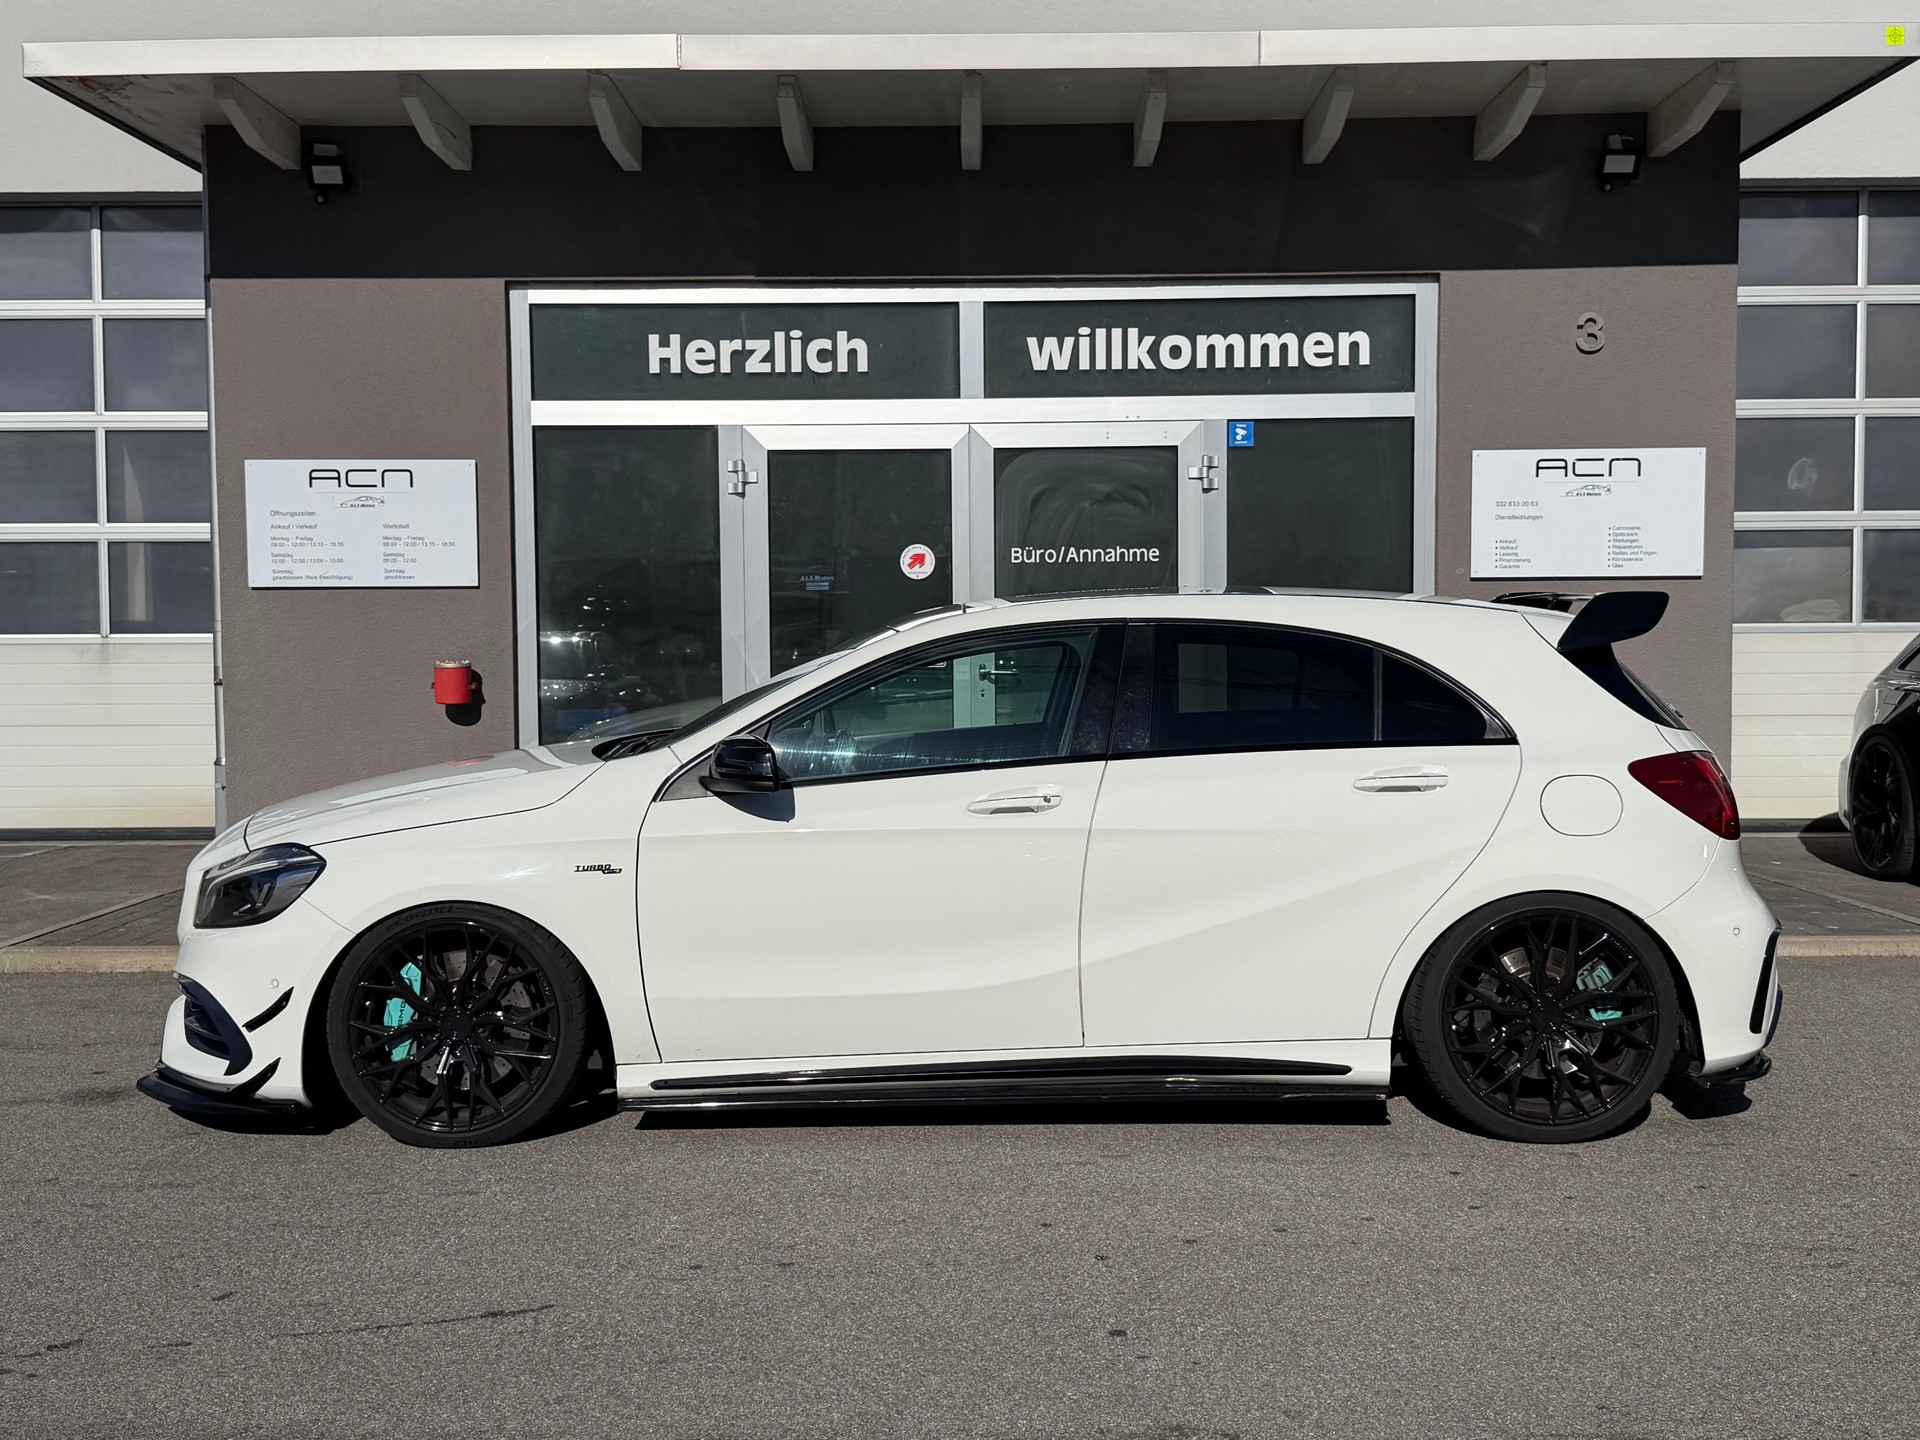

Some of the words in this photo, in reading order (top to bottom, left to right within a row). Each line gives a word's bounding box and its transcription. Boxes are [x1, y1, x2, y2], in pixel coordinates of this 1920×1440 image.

[1576, 311, 1605, 352] 3
[647, 330, 868, 375] Herzlich
[1026, 327, 1370, 372] willkommen
[309, 468, 414, 488] ACN
[1535, 458, 1641, 478] ACN
[270, 510, 316, 518] Öffnungszeiten
[1010, 546, 1160, 564] Büro/Annahme
[574, 864, 611, 872] TURBO
